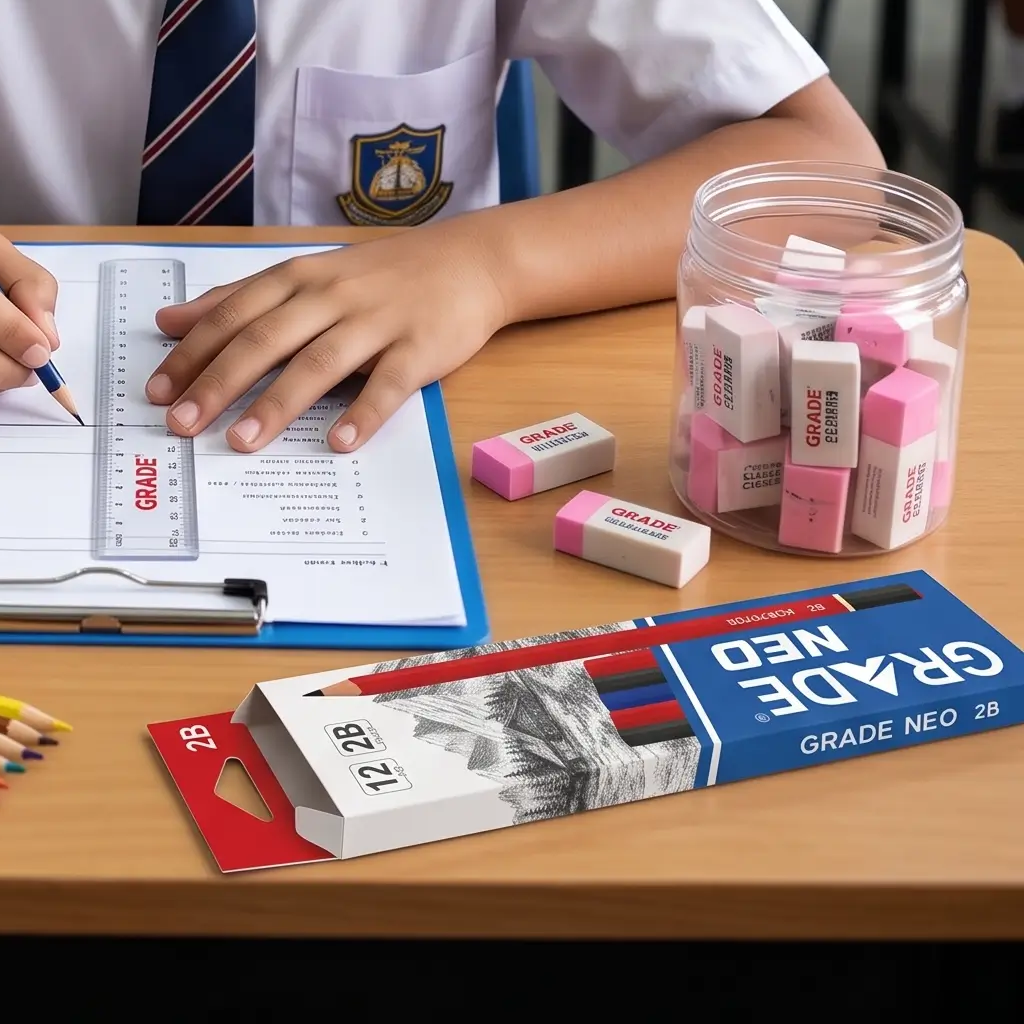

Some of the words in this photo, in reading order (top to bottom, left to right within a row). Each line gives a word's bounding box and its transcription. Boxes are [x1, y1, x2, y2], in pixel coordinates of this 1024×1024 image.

[806, 389, 822, 447] GRADE
[519, 422, 578, 444] GRADE
[135, 457, 157, 511] GRADE
[612, 508, 678, 532] GRADE
[710, 625, 849, 671] NEO
[179, 724, 217, 752] 2B
[332, 723, 375, 752] 2B
[800, 720, 893, 754] GRADE
[904, 708, 958, 735] NEO
[974, 700, 1000, 720] 2B
[358, 763, 398, 791] 12
